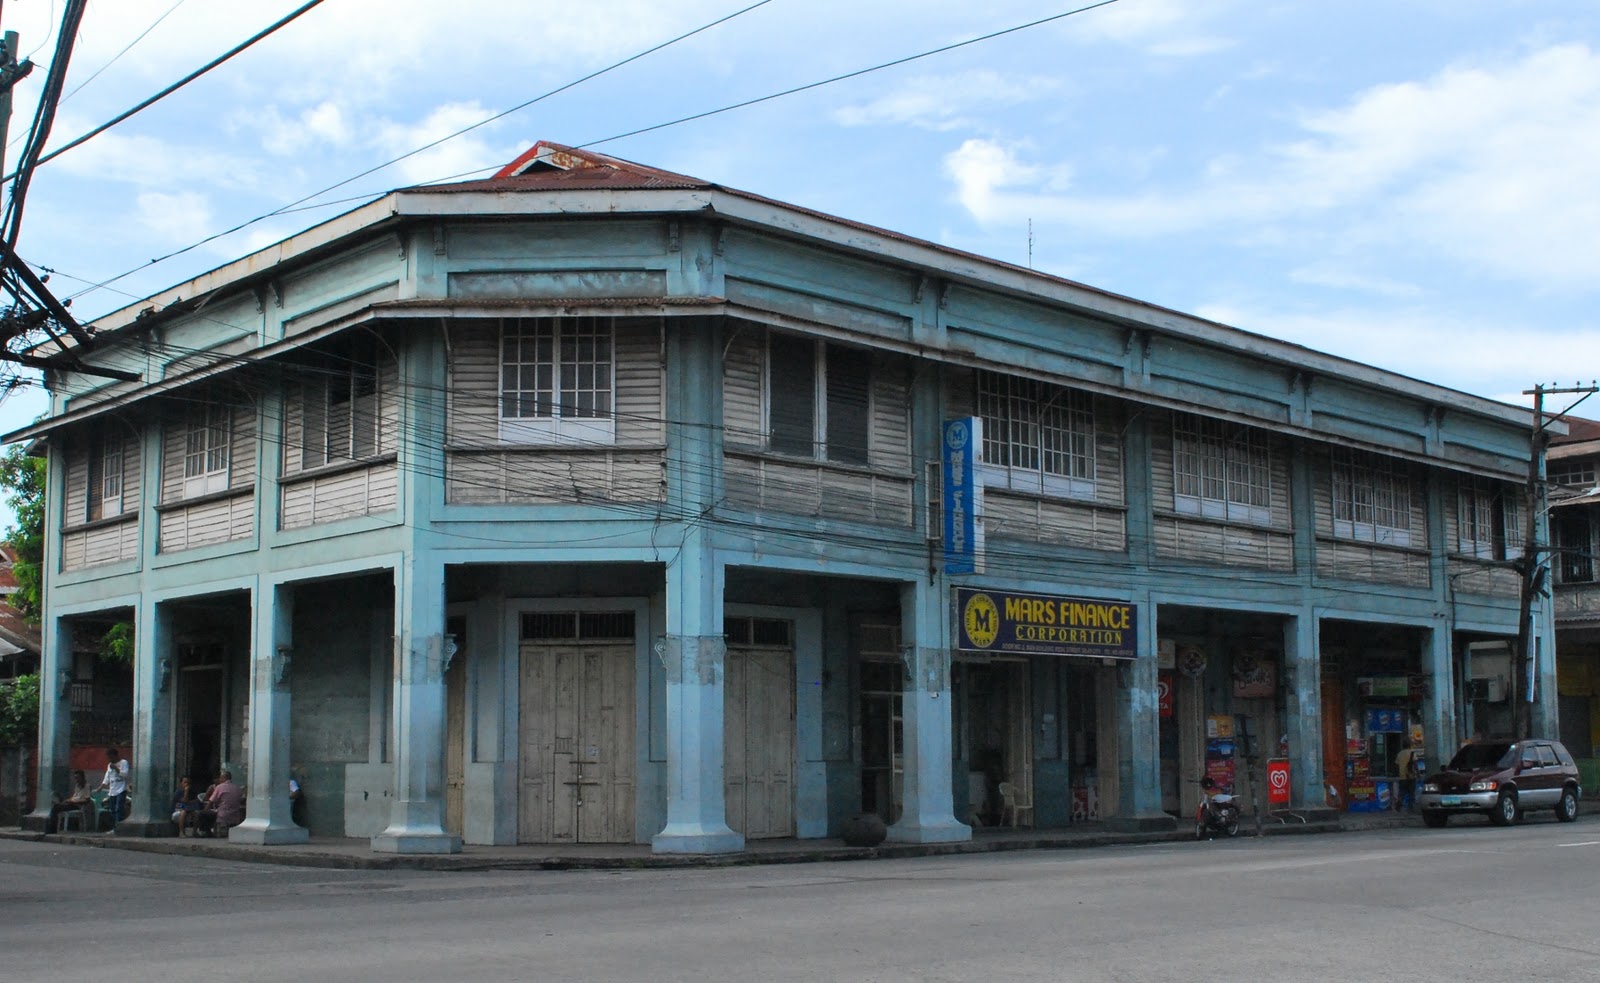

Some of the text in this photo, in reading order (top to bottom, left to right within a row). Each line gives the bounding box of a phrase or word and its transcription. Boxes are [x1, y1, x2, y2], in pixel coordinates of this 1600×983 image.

[974, 608, 990, 632] M
[1005, 597, 1130, 629] MARS FINANCE
[1016, 626, 1121, 644] CORPORATION
